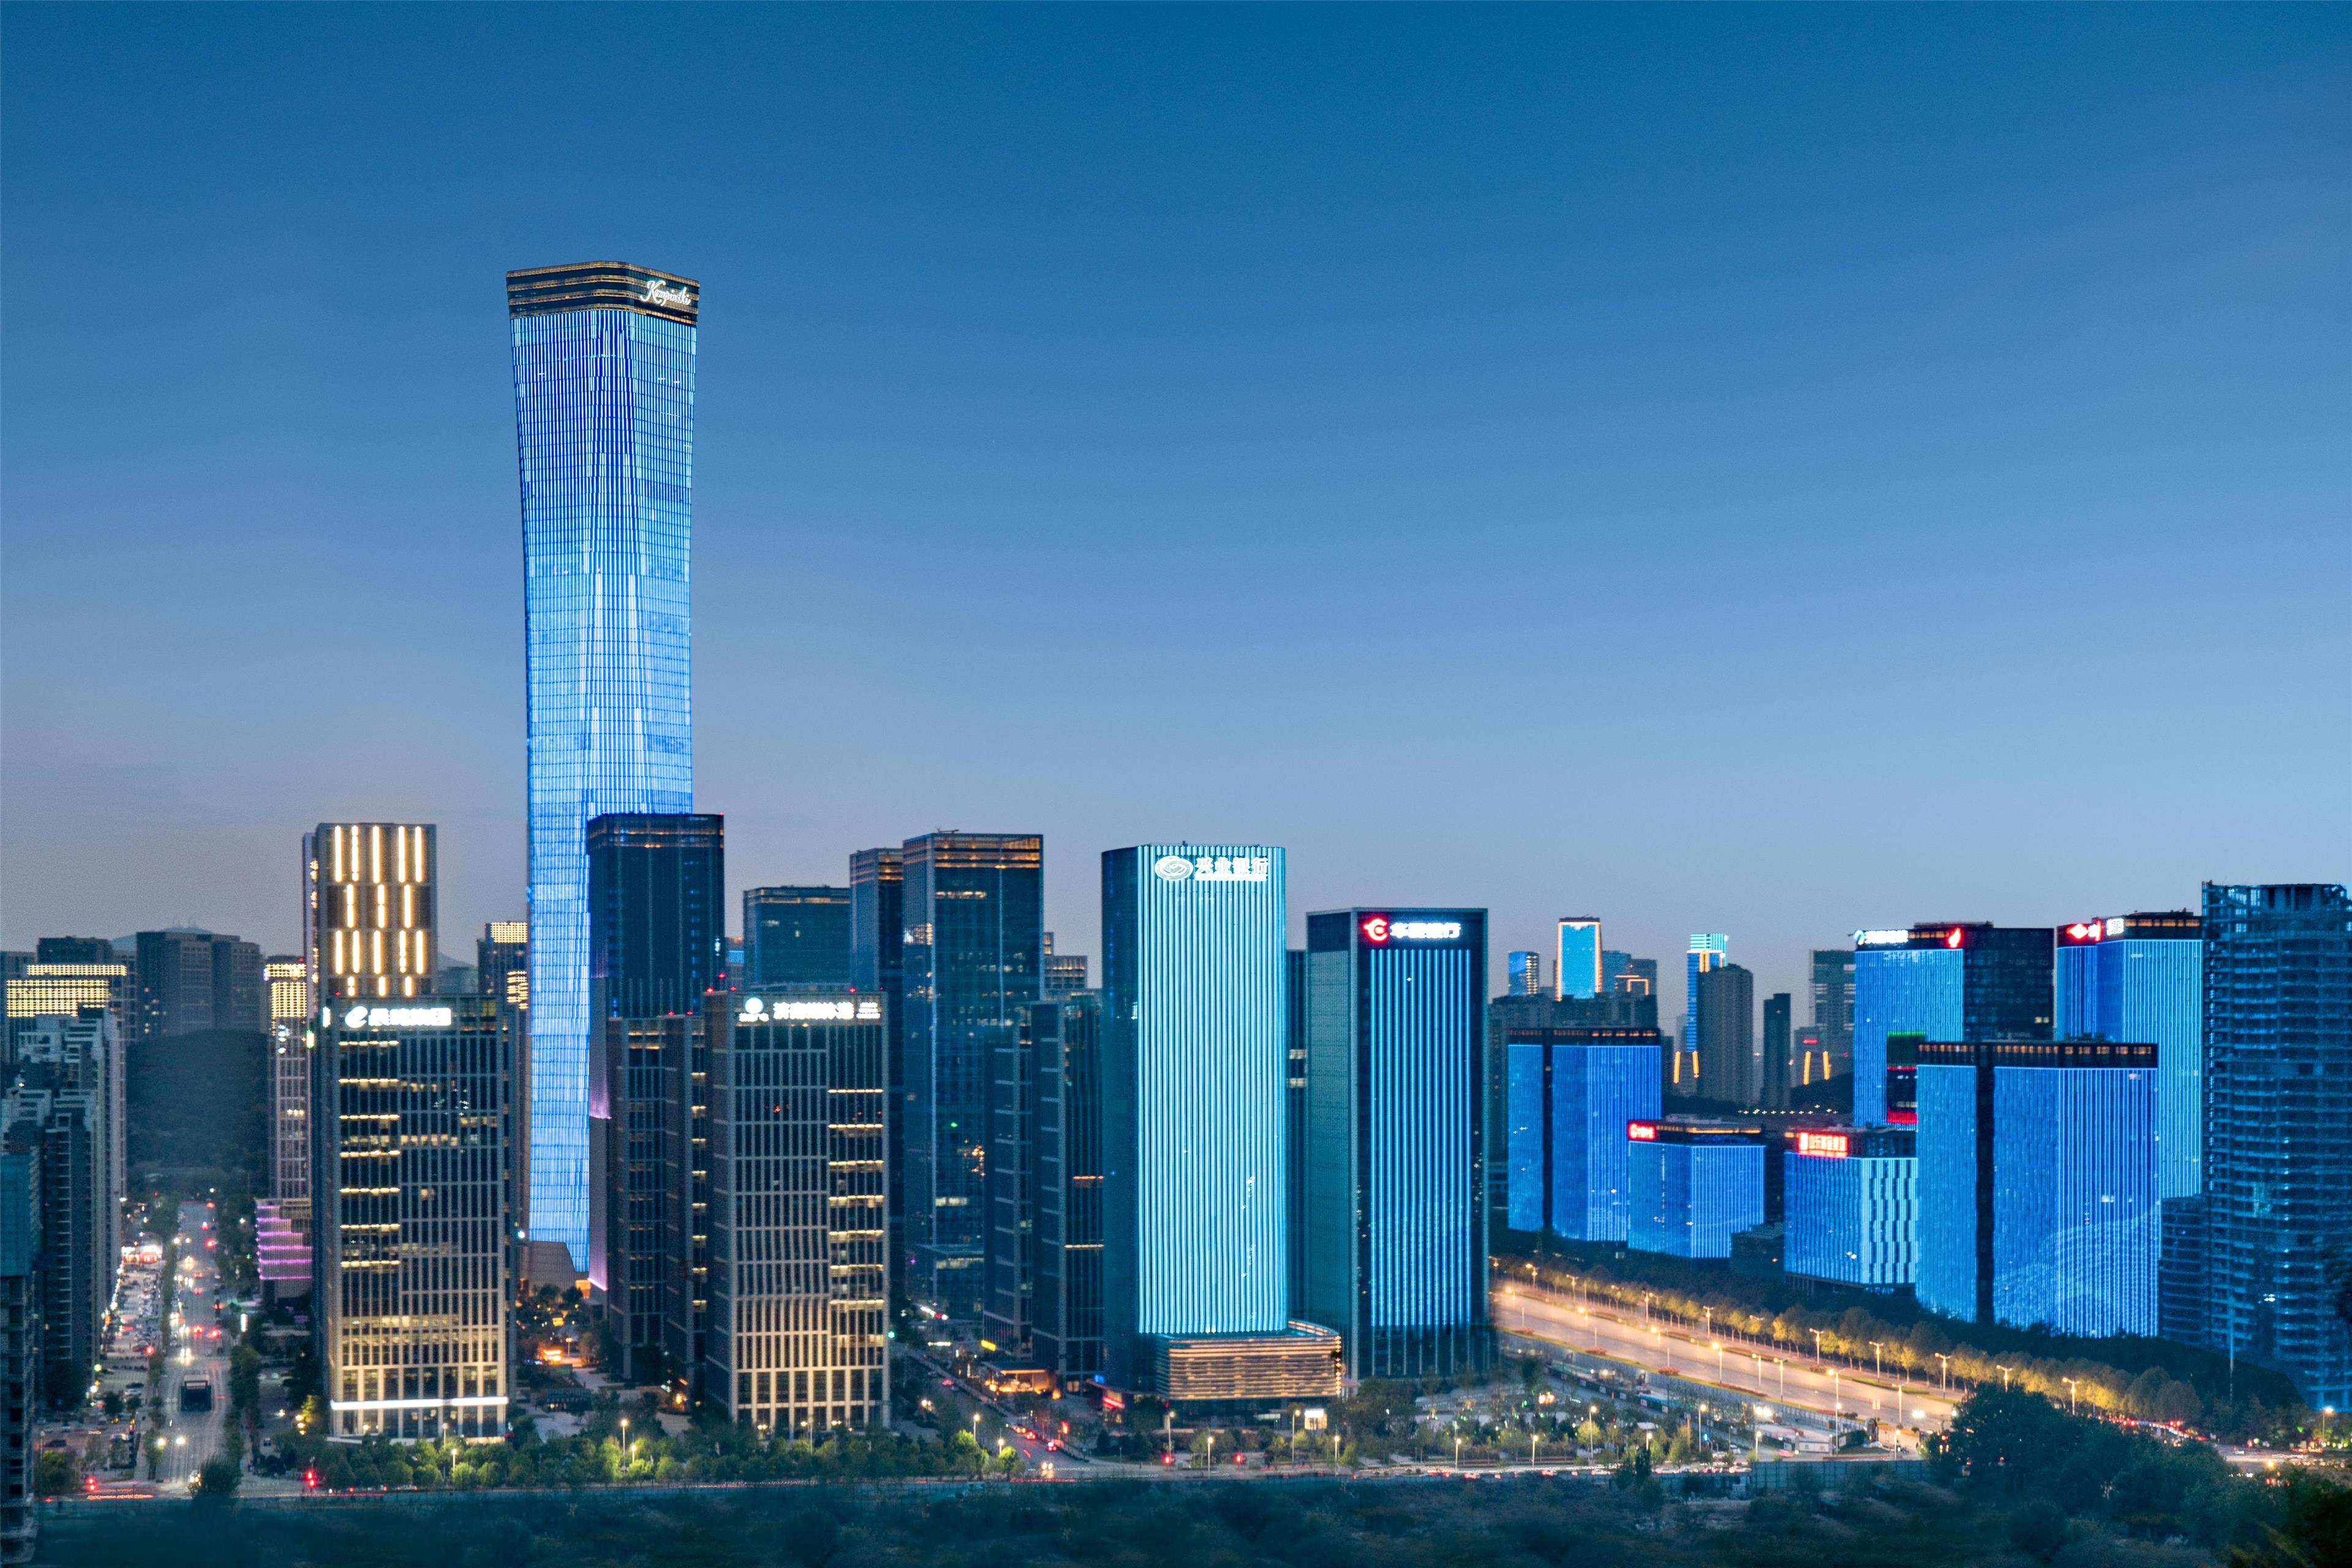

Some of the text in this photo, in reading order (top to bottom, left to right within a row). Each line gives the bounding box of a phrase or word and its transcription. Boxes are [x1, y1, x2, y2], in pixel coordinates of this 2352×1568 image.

[640, 280, 691, 306] Kempinski
[1195, 857, 1268, 874] 兴业银行
[1390, 922, 1461, 938] 华行
